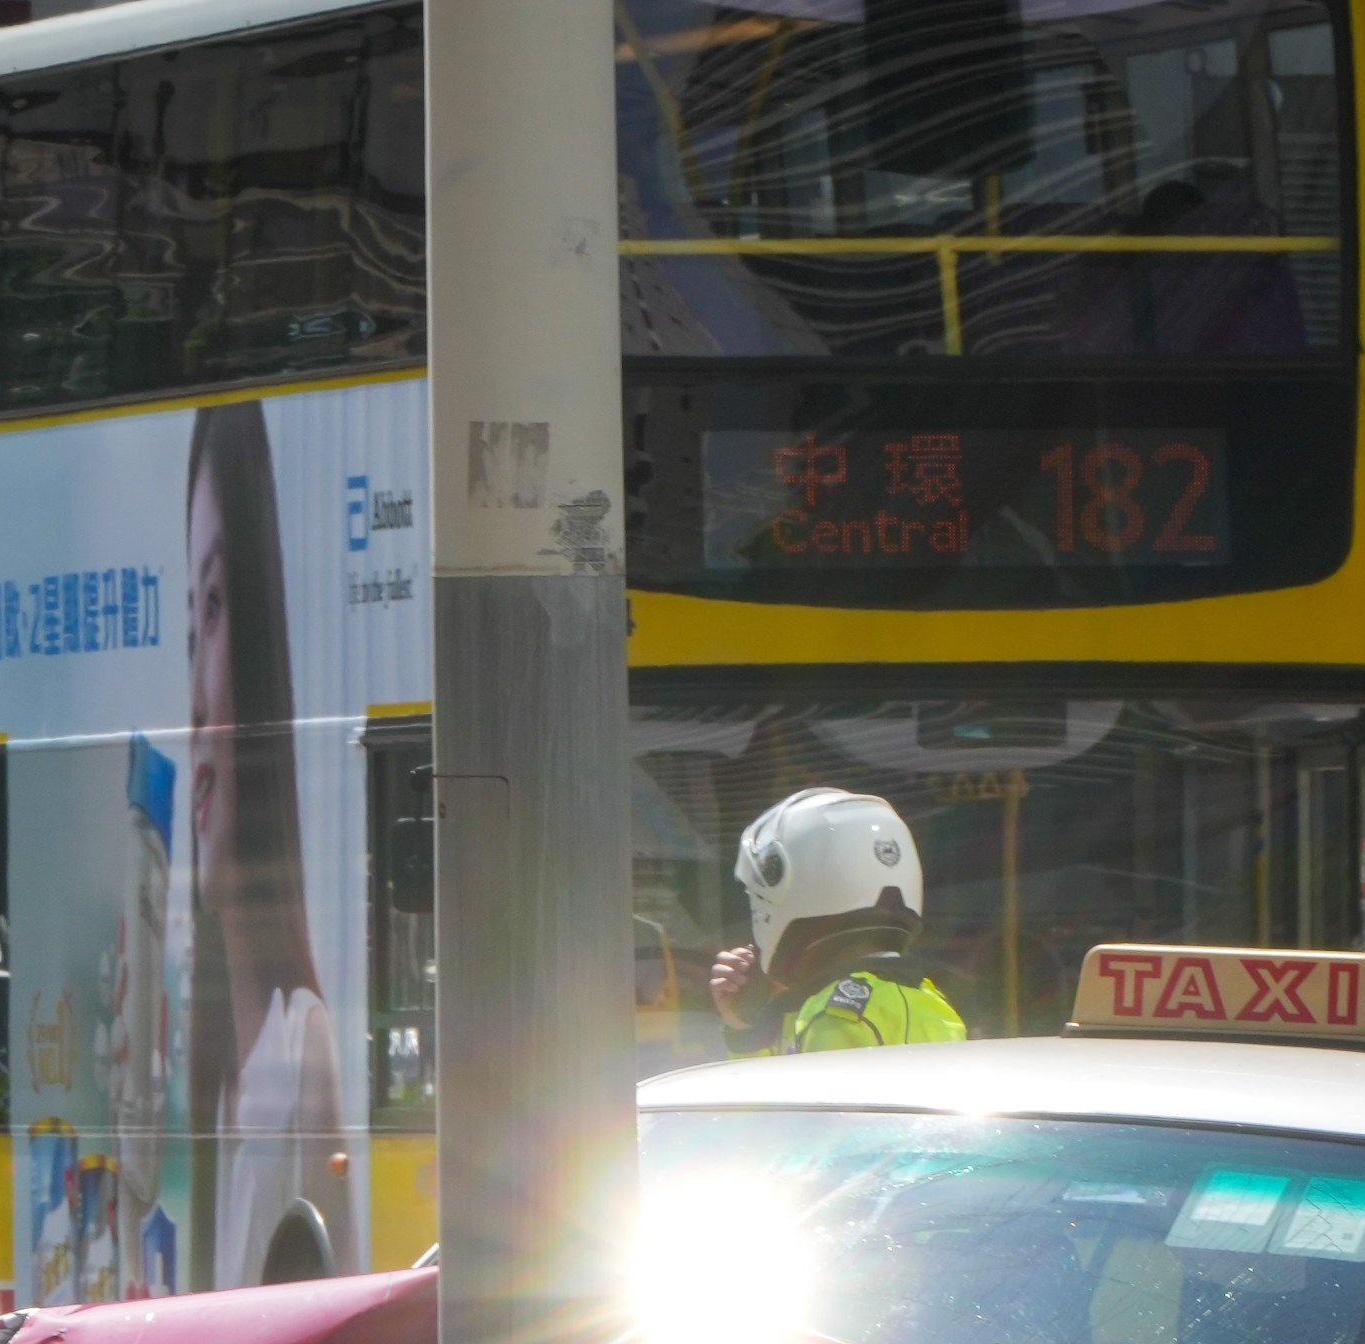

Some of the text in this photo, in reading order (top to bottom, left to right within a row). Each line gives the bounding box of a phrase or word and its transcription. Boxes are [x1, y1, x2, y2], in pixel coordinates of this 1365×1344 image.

[771, 434, 963, 508] 中環
[1038, 442, 1217, 553] 182
[770, 507, 970, 554] Central
[1099, 952, 1360, 1028] TAXI
